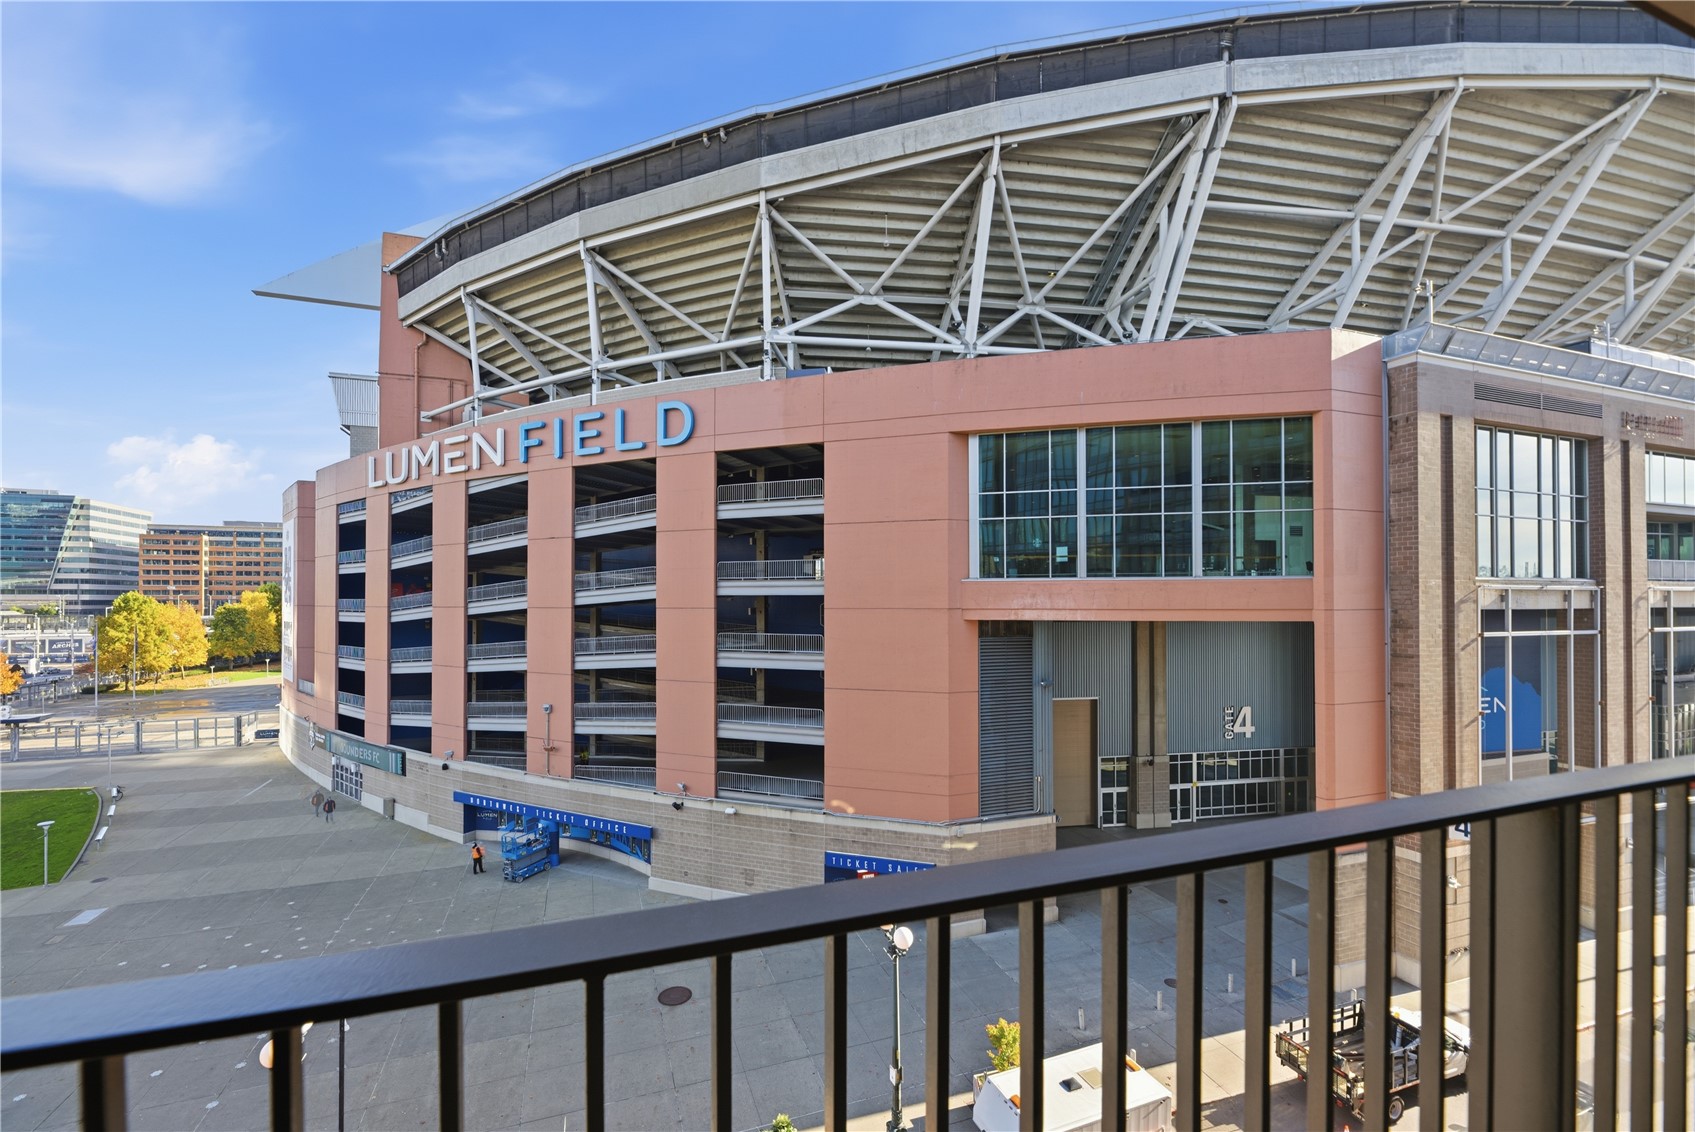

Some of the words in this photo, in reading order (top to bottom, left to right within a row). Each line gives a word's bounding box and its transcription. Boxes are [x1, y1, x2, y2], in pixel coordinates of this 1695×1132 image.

[368, 427, 505, 488] LUMEN
[519, 400, 695, 464] FIELD
[1224, 706, 1234, 739] GATE
[1233, 705, 1256, 738] 4
[372, 751, 380, 764] FC
[536, 809, 574, 823] TICKET
[584, 818, 627, 834] OFFICE
[832, 857, 877, 870] TICKET
